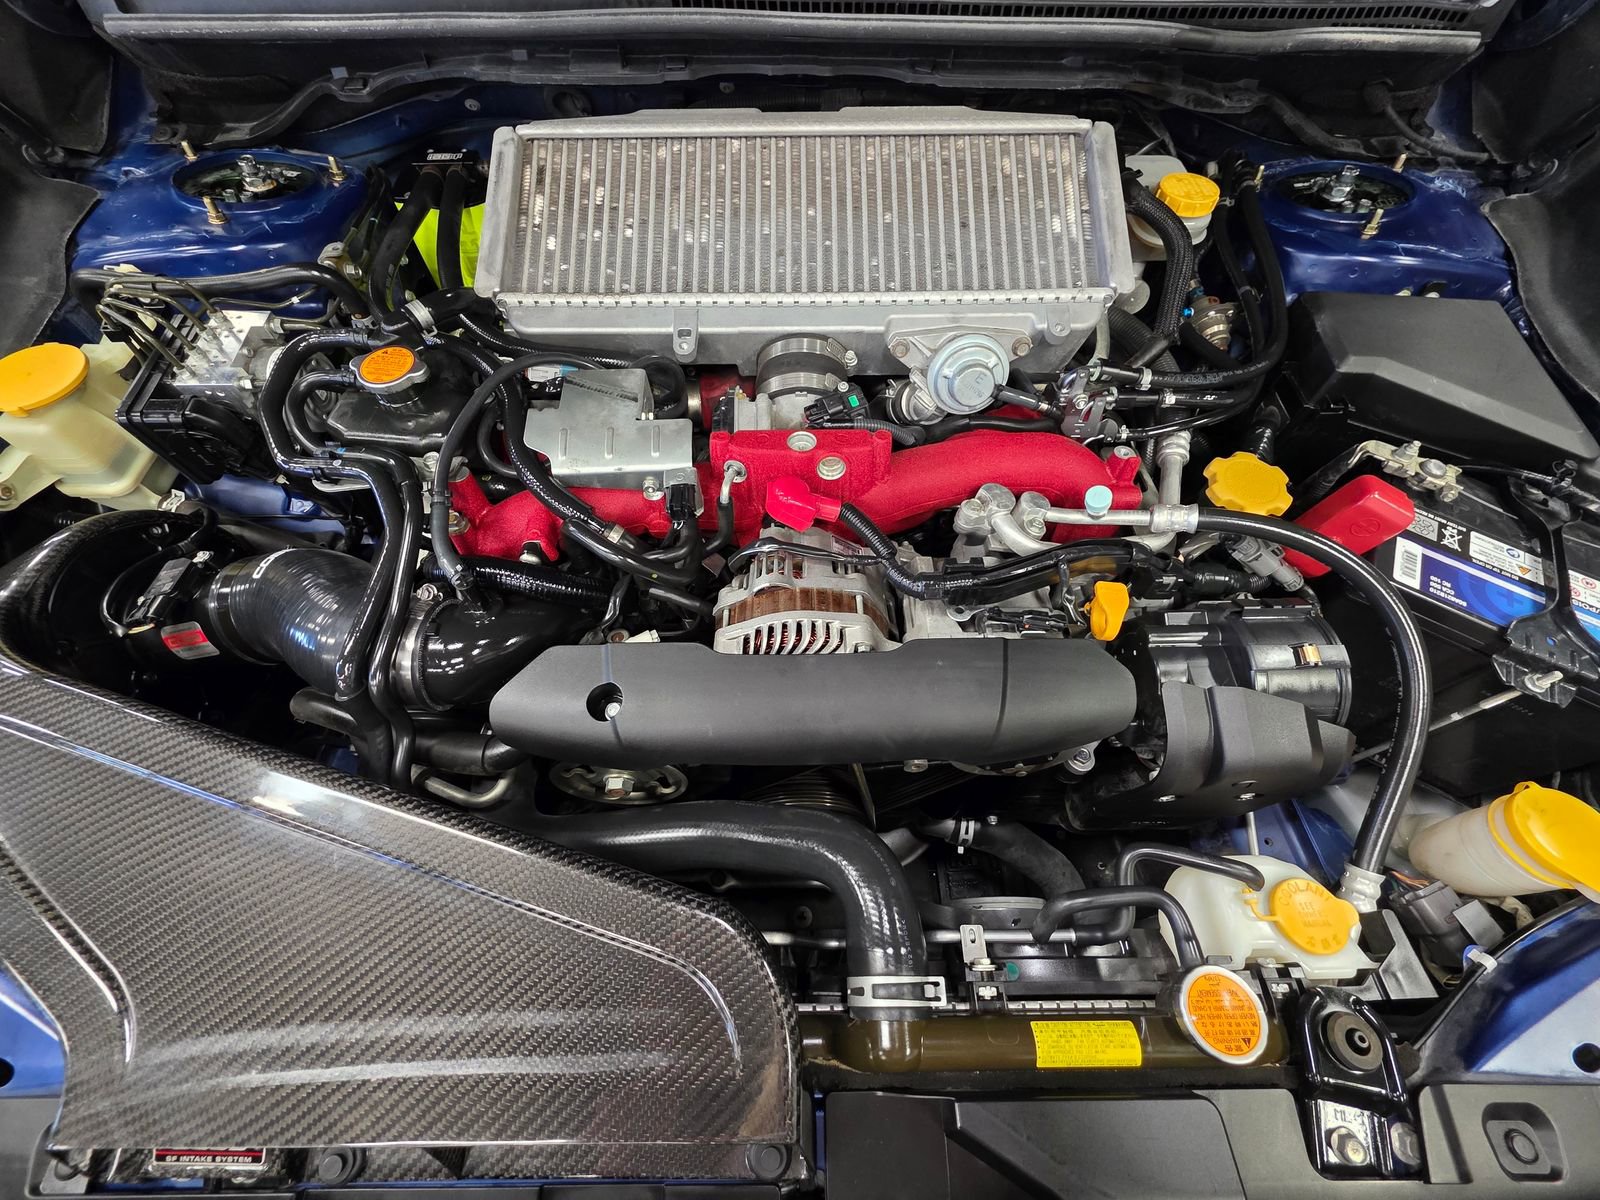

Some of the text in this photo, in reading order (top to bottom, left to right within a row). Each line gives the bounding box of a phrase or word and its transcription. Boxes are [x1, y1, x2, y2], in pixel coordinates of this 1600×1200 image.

[1442, 585, 1455, 595] CCA
[1212, 1036, 1242, 1045] WARNING
[215, 1155, 252, 1163] SYSTEM
